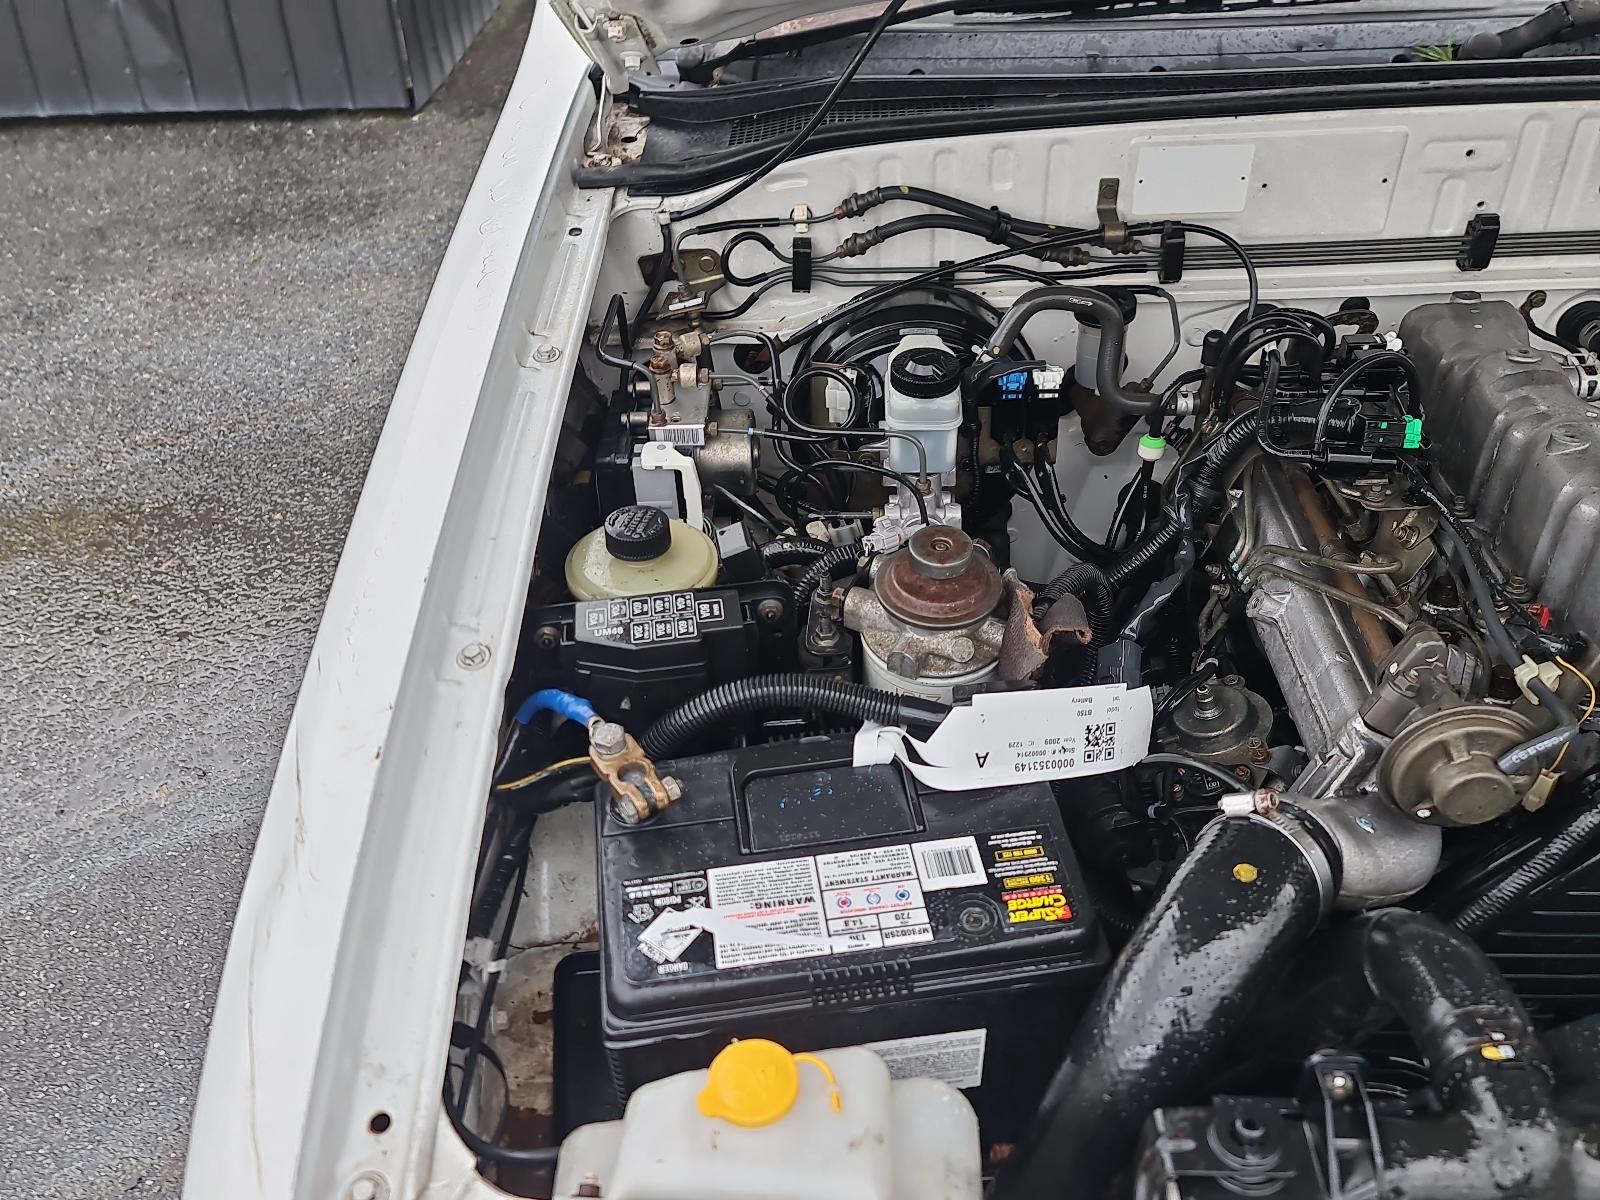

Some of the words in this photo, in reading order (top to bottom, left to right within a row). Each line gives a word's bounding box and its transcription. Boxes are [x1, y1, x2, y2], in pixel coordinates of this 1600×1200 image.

[1072, 696, 1092, 704] Battery
[1044, 738, 1060, 746] 2009
[975, 752, 990, 768] A
[1014, 758, 1074, 772] 0000353149
[871, 870, 914, 881] WARRANTY
[824, 876, 869, 887] STATEMENT
[750, 896, 816, 910] WARNING:
[1008, 894, 1066, 911] CHARGE
[894, 912, 911, 921] 720
[1008, 907, 1057, 923] SUPER
[843, 918, 863, 927] 14.8
